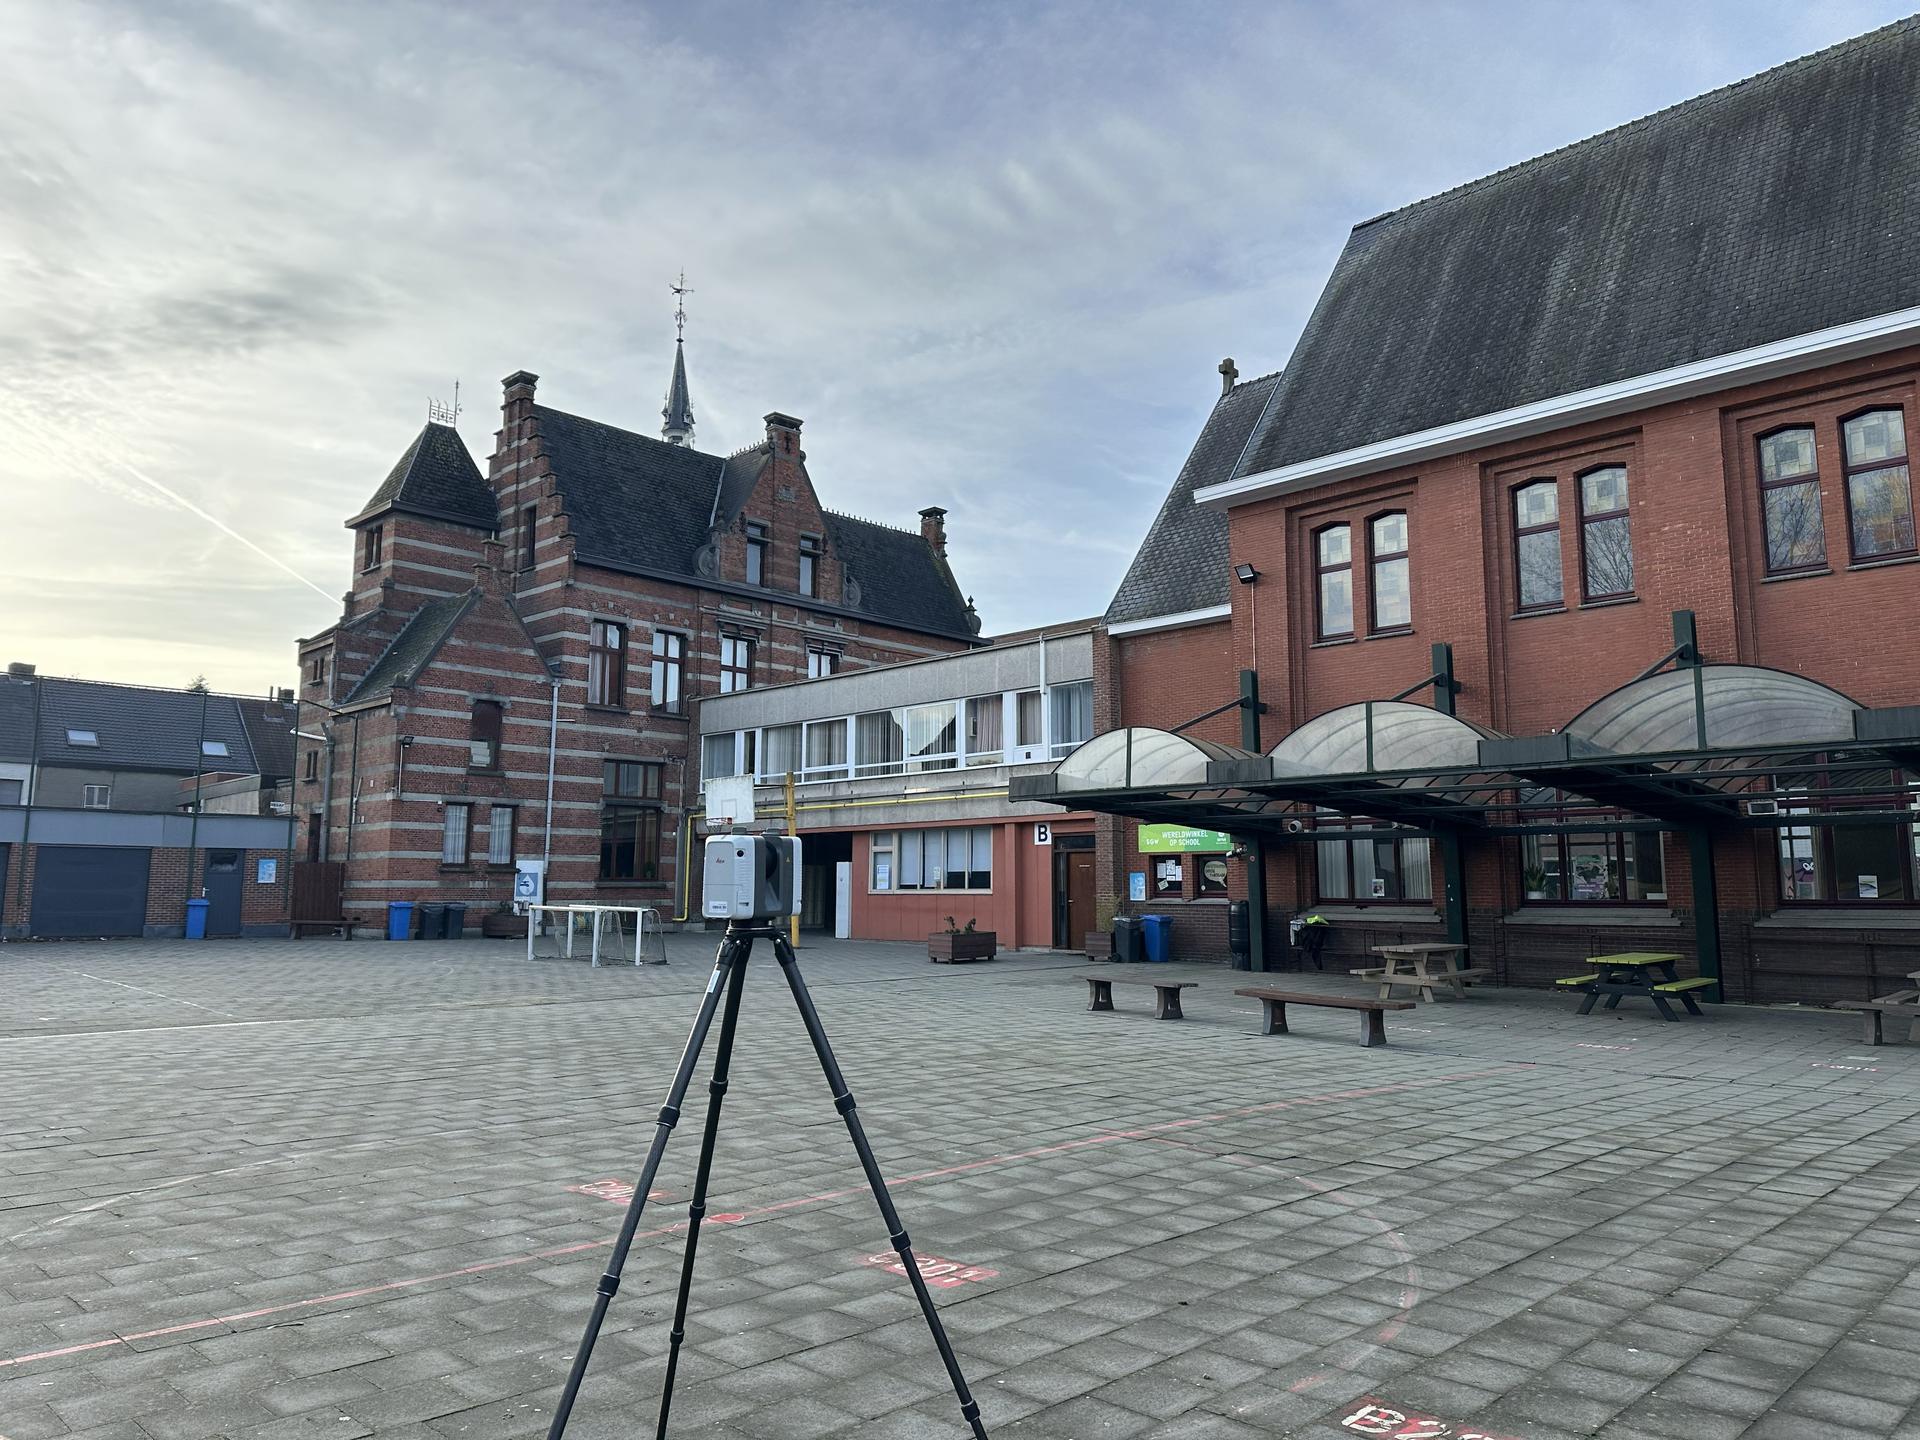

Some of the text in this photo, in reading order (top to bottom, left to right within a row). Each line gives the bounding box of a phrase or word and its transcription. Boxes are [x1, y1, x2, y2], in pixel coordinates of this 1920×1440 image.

[1037, 824, 1048, 842] B
[1161, 829, 1209, 839] WERELDWINKEL
[1169, 838, 1200, 847] OP SCHOOL
